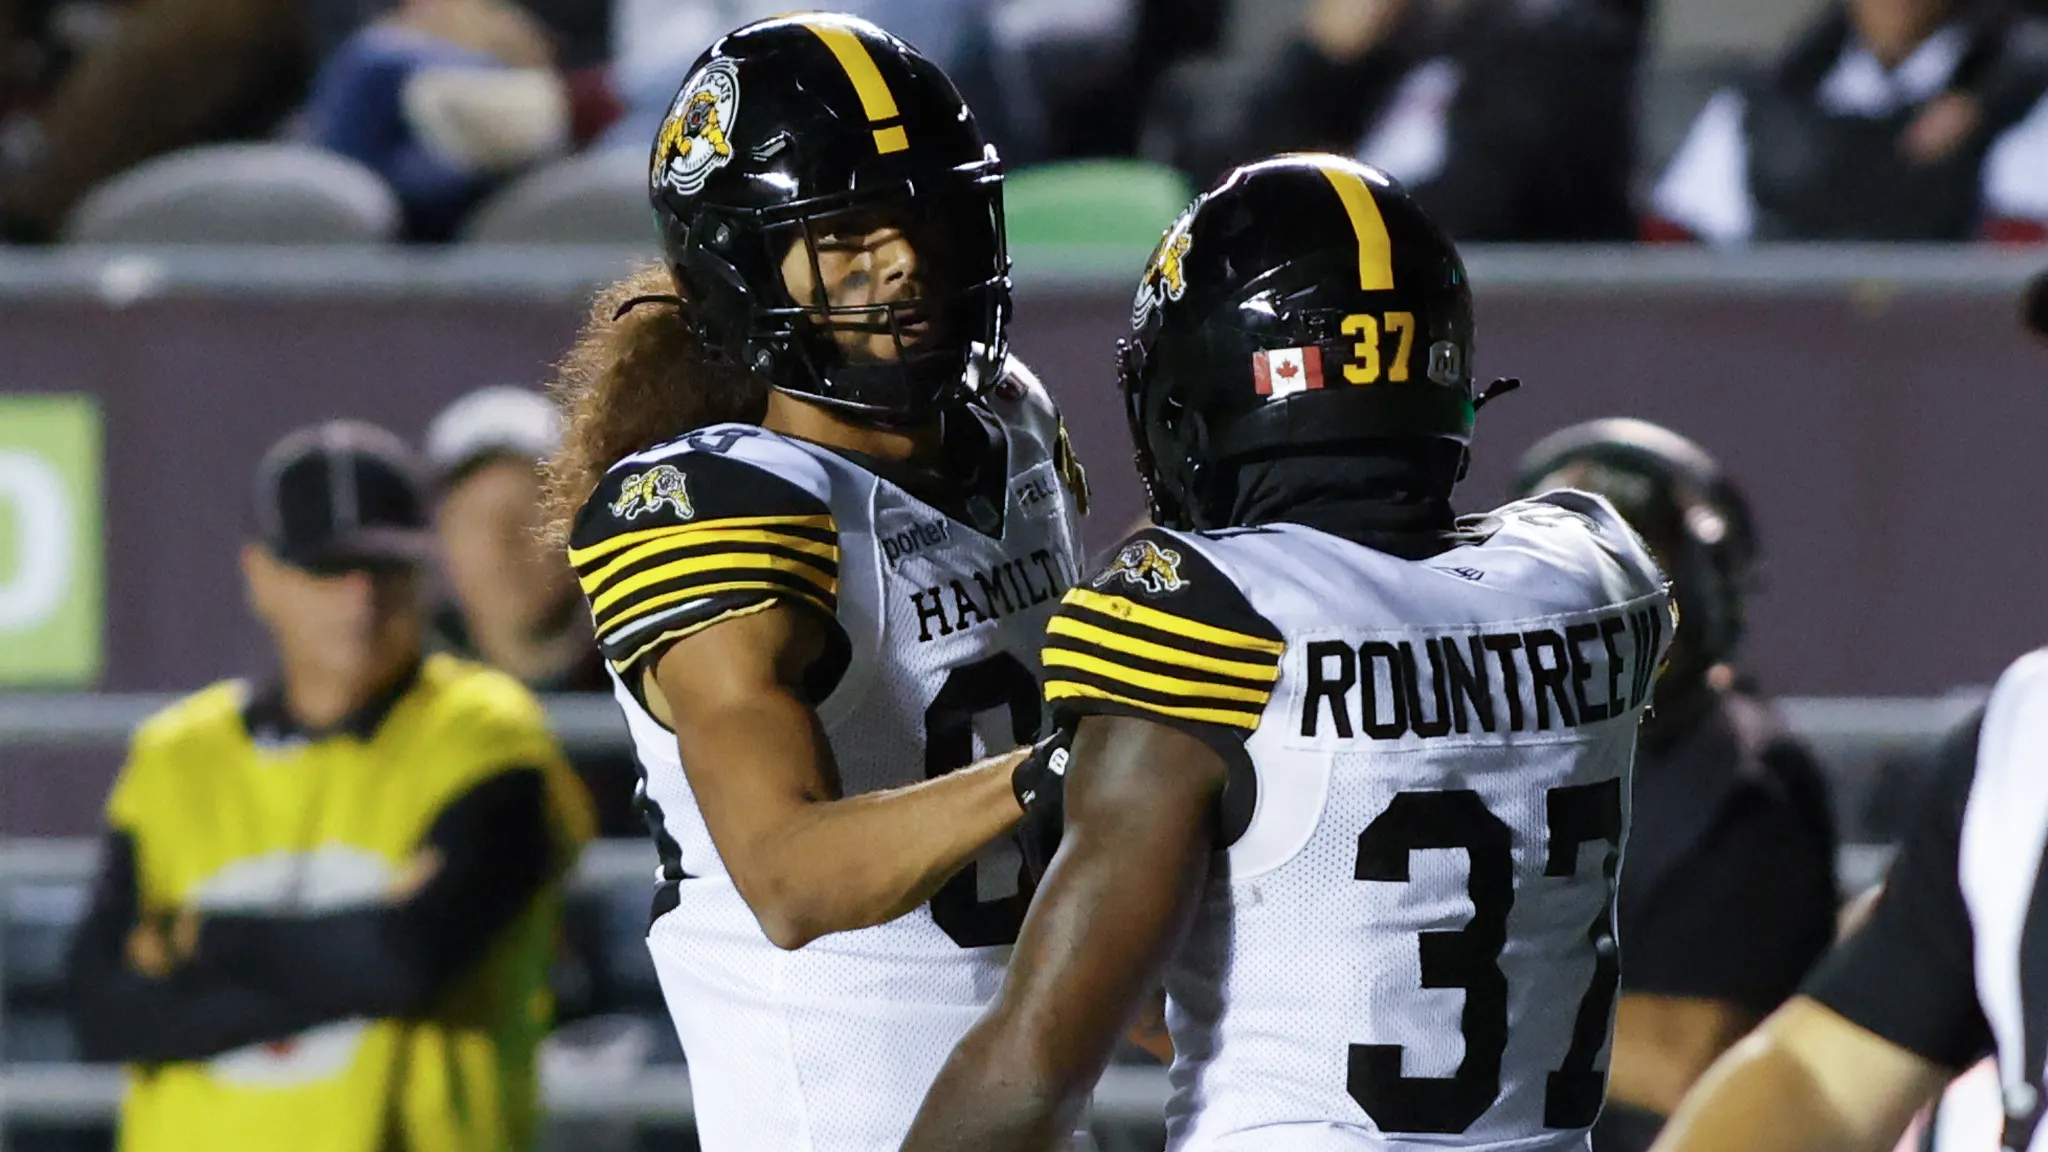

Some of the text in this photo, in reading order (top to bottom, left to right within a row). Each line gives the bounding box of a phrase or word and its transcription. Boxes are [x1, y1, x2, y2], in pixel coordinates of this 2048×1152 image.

[1341, 311, 1415, 385] 37
[881, 518, 948, 568] porter
[910, 548, 1063, 643] HAMILT
[1300, 617, 1626, 740] ROUNTREE
[1346, 777, 1621, 1134] 37
